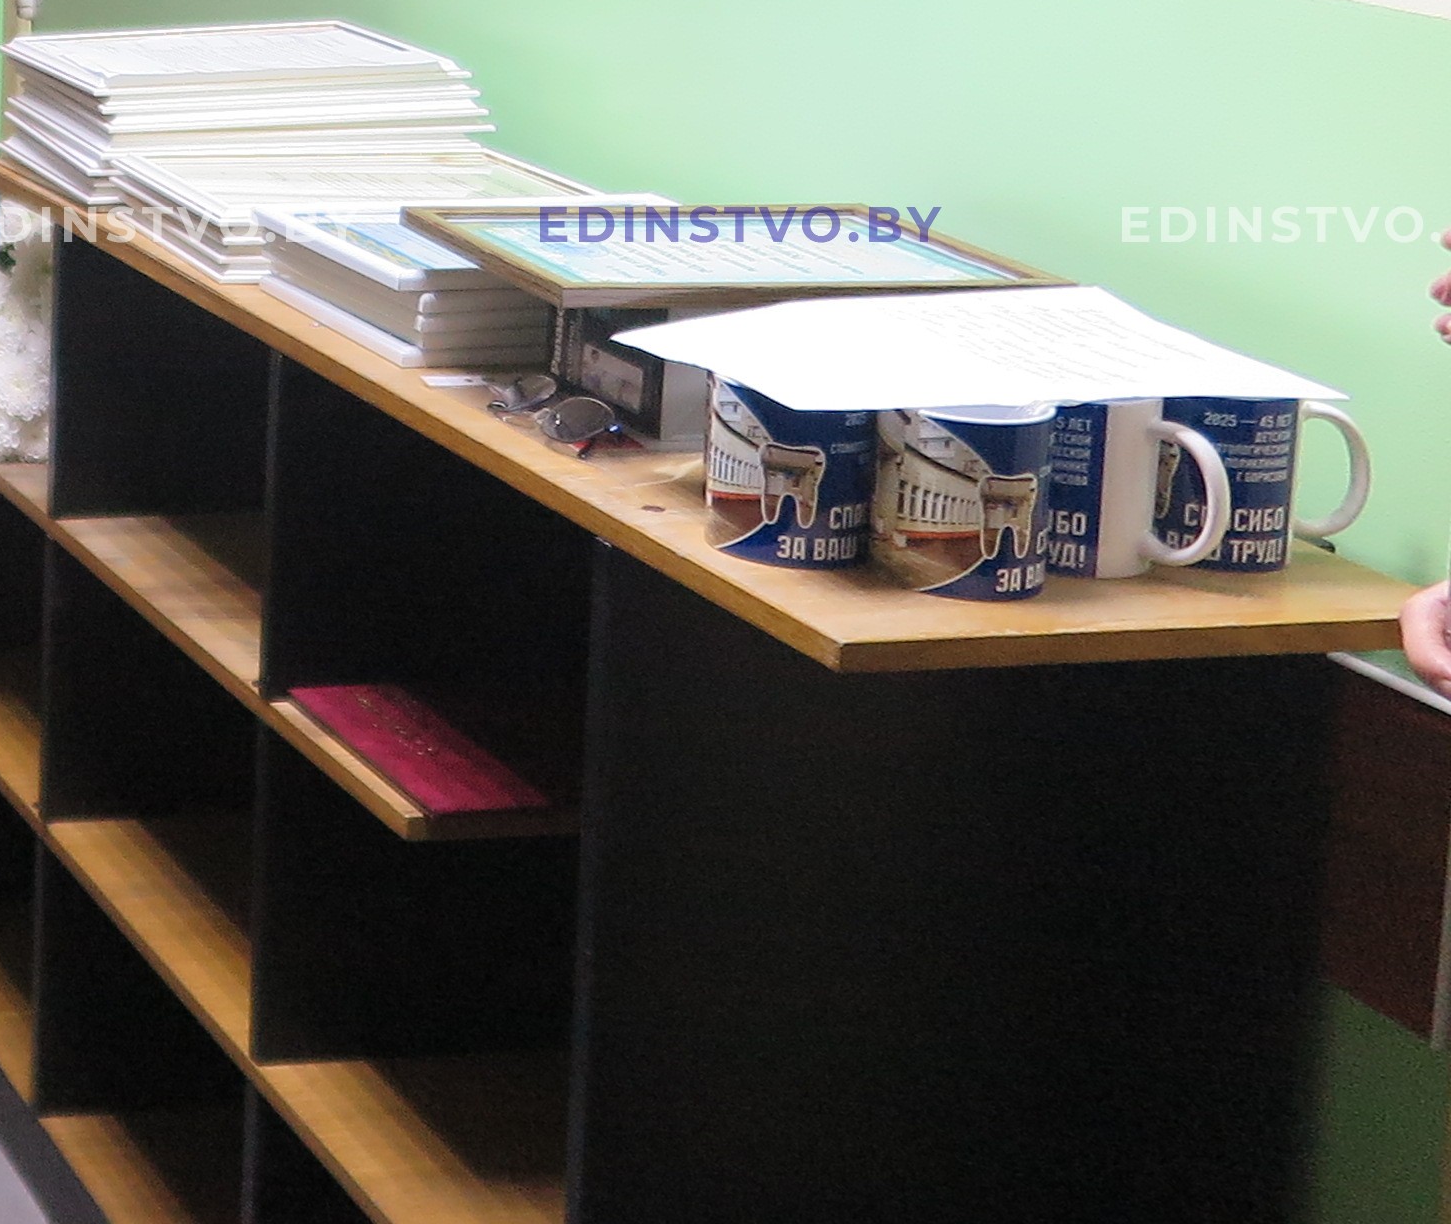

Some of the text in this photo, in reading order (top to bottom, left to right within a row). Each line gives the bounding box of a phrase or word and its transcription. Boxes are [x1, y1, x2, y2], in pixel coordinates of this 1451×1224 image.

[1184, 503, 1285, 531] ССИБО
[776, 535, 806, 561] ЗА
[995, 567, 1021, 592] ЗА
